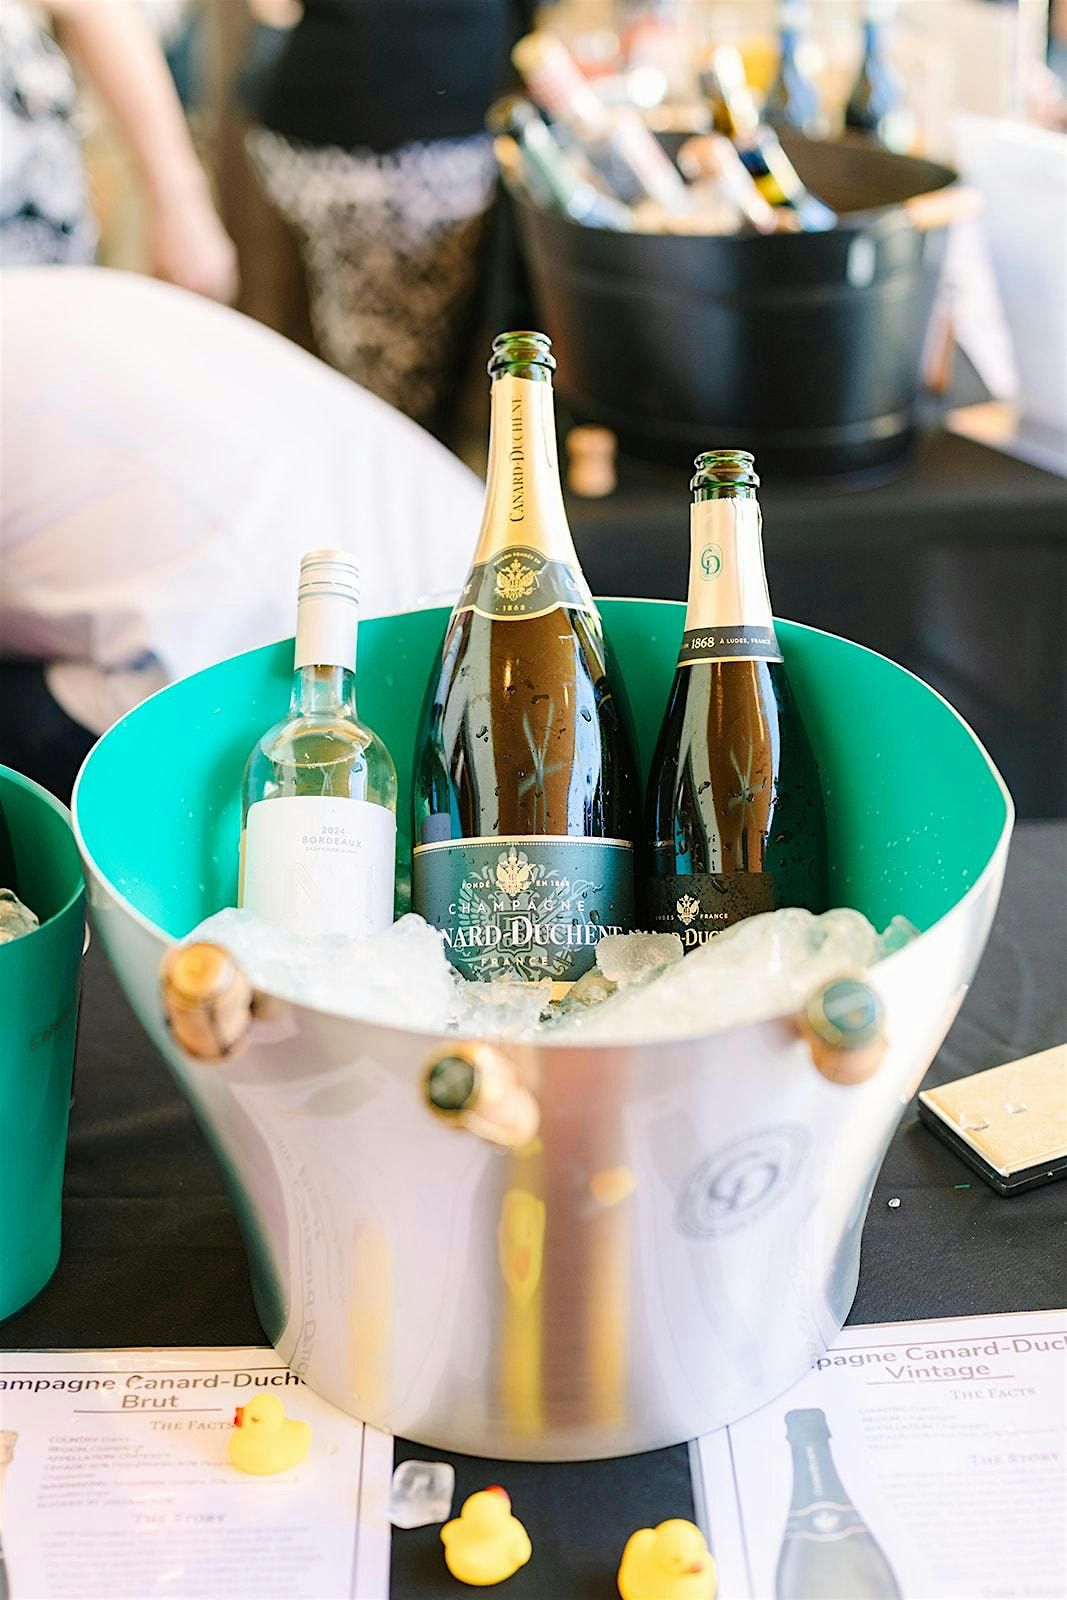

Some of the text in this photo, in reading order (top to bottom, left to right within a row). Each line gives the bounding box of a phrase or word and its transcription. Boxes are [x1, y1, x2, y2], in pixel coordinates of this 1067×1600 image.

[691, 636, 715, 649] 1868
[321, 826, 345, 835] 2024
[302, 836, 362, 848] BORDEAUX
[448, 900, 586, 915] CHAMPAGNE
[481, 957, 549, 967] FRANCE
[811, 1353, 897, 1370] pagne
[884, 1364, 991, 1380] Vintage
[126, 1371, 307, 1390] Canard-Duch
[121, 1394, 179, 1409] Brut
